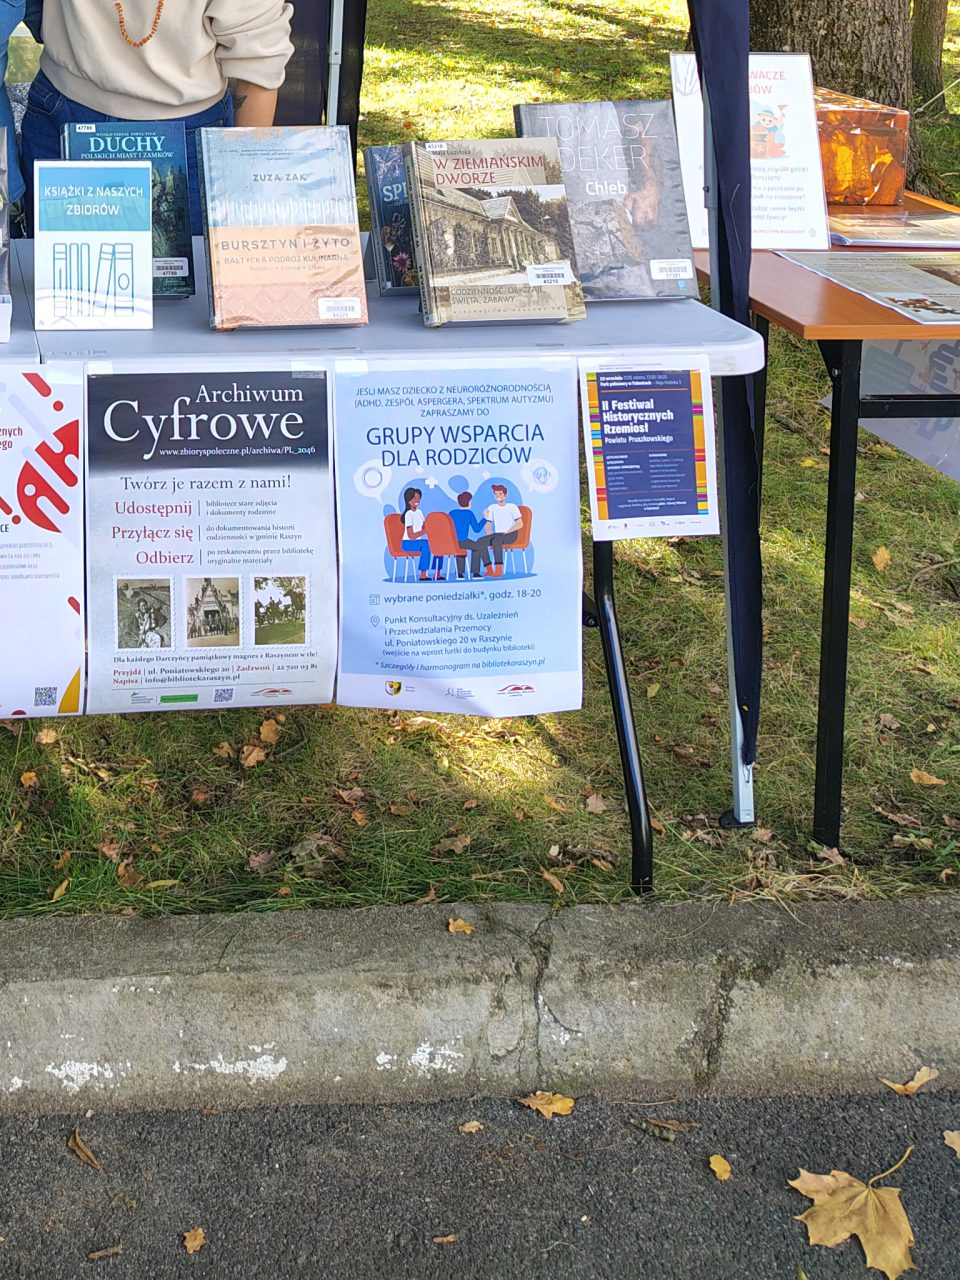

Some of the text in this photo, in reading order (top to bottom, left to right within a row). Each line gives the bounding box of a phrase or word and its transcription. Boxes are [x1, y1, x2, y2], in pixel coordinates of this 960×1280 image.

[539, 113, 658, 141] TOMASZ
[89, 136, 165, 152] DUCHY
[434, 154, 543, 170] W ZIEMIAŃSKIM
[559, 145, 649, 172] DEKER
[253, 173, 281, 182] ZUZA
[436, 172, 496, 185] DWORZE
[44, 185, 143, 199] KSIĄŻKI Z NASZYCH
[586, 181, 627, 196] Chleb
[67, 202, 120, 215] ZBIORÓW
[221, 240, 297, 251] BURSZTYN
[312, 237, 350, 249] ŻYTO
[195, 383, 304, 404] Archiwum
[356, 383, 551, 396] JEŚLI MASZ DZIECKO Z NEURORÓŻNORODNOŚCIĄ
[385, 398, 415, 407] ZESPÓŁ
[417, 397, 465, 406] ASPERGERA,
[467, 396, 509, 405] SPEKTRUM
[512, 395, 553, 404] AUTYZMU)
[602, 398, 654, 410] II Festiwal
[420, 408, 489, 418] ZAPRASZAMY DO
[603, 409, 674, 423] Historycznych
[103, 396, 304, 460] Cyfrowe
[366, 424, 544, 446] GRUPY WSPARCIA
[604, 422, 648, 434] Rzemiosł
[605, 434, 673, 444] Powiatu Pruszkowskiego
[382, 446, 532, 467] DLA RODZICÓW
[120, 475, 291, 494] Twórz je razem z nami!
[115, 500, 192, 517] Udostępnij
[112, 525, 193, 542] Przyłącz się
[136, 549, 194, 564] Odbierz
[384, 593, 423, 604] wybrane
[489, 591, 514, 602] godz.
[517, 589, 541, 598] 18-20
